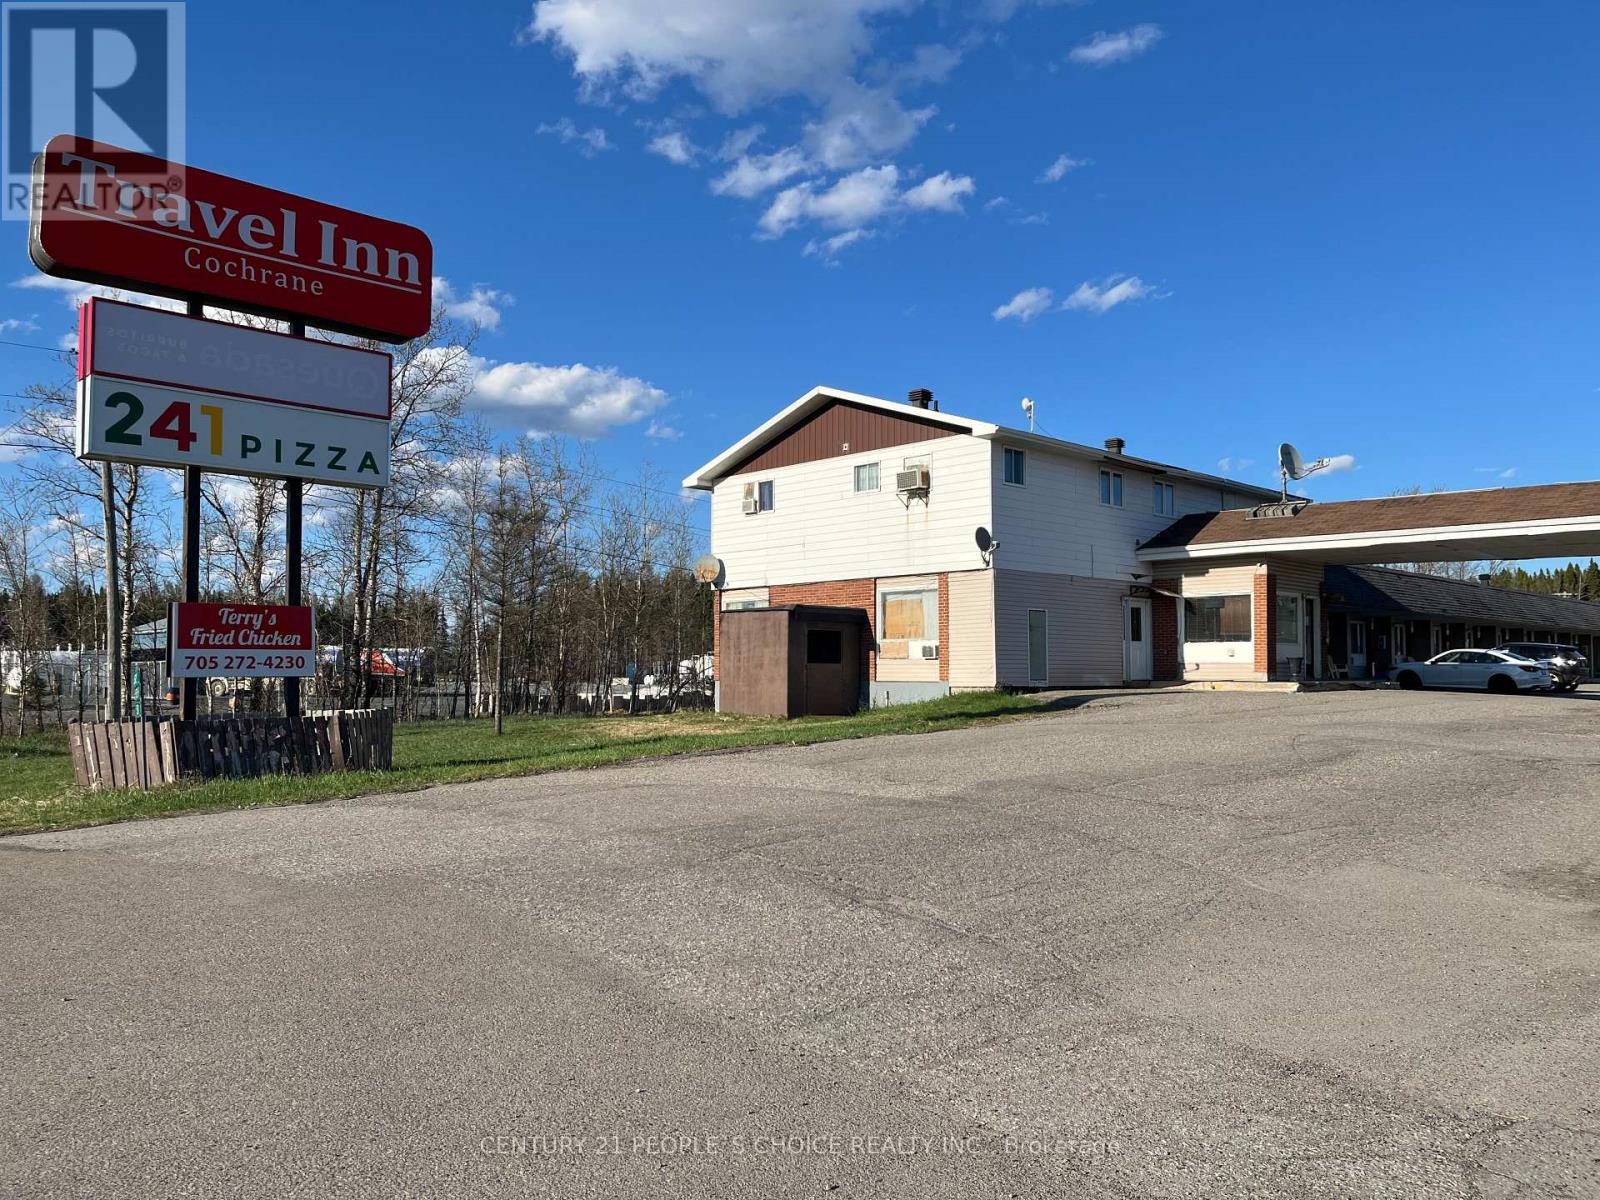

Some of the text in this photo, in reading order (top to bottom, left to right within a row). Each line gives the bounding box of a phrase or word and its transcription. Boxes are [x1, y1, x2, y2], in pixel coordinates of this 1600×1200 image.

[61, 152, 421, 286] Travel Inn
[184, 246, 324, 296] Cochrane
[104, 391, 380, 475] 241 PIZZA
[190, 627, 301, 646] Fried Chicken
[218, 607, 277, 630] Terry's
[185, 655, 305, 670] 705 272-4230
